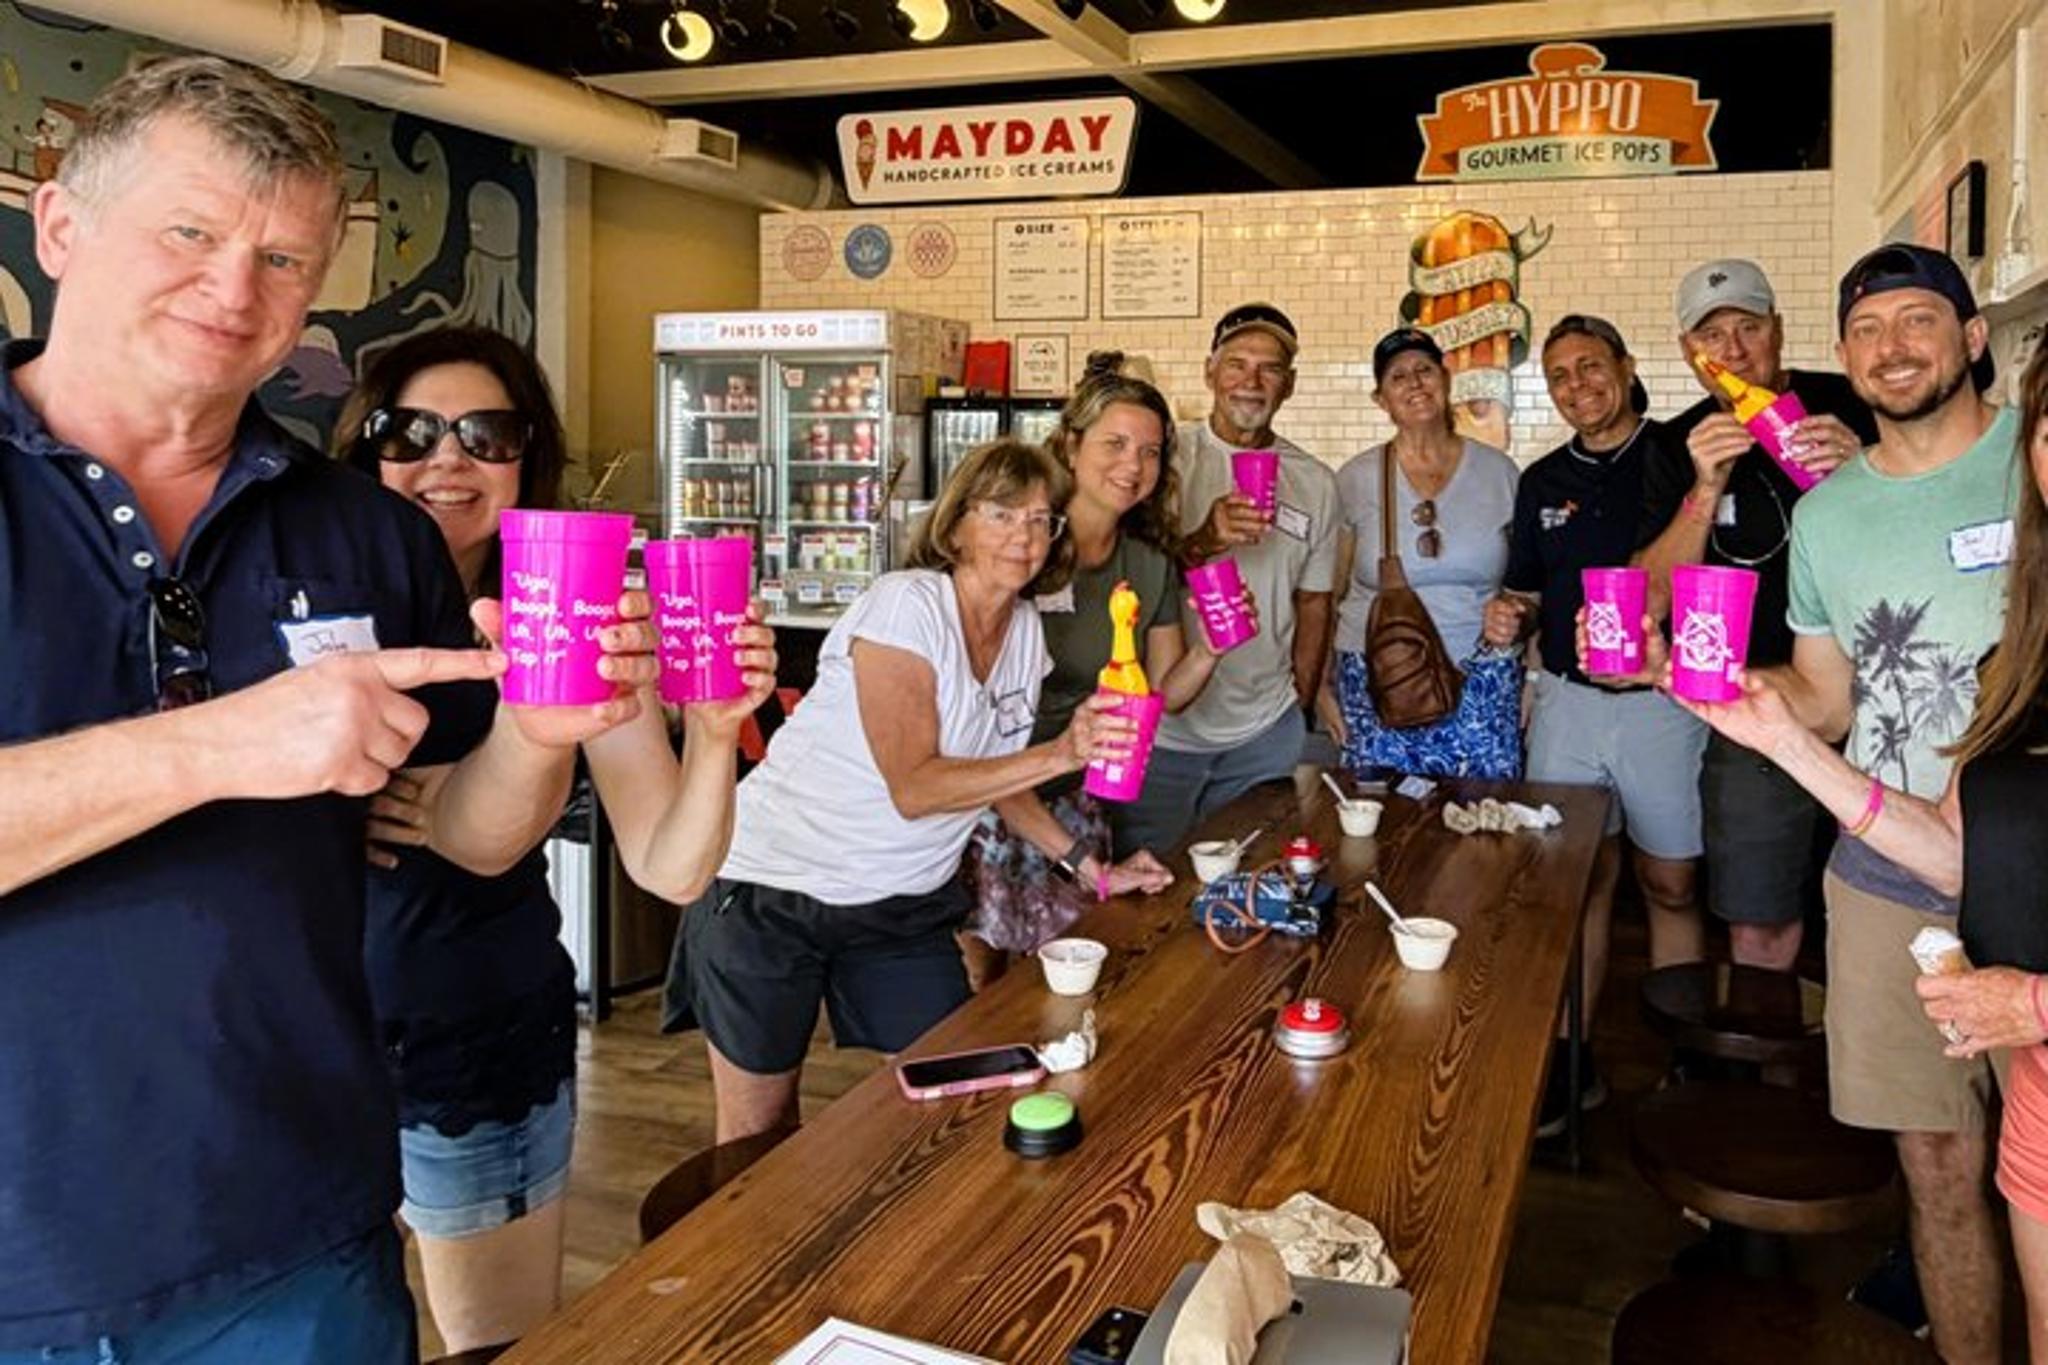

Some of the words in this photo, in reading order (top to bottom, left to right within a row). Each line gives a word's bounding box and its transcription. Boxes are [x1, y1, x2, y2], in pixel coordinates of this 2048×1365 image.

[1489, 79, 1643, 139] HYPPO
[886, 115, 1113, 162] MAYDAY
[1466, 143, 1568, 170] GOURMET
[1575, 142, 1604, 163] ICE
[1611, 142, 1661, 163] POPS
[883, 163, 1005, 184] HANDCRAFTED
[1008, 163, 1037, 178] ICE
[1043, 159, 1115, 177] CREAMS
[719, 323, 766, 338] PINTS
[770, 323, 792, 338] TO
[796, 323, 818, 337] GO
